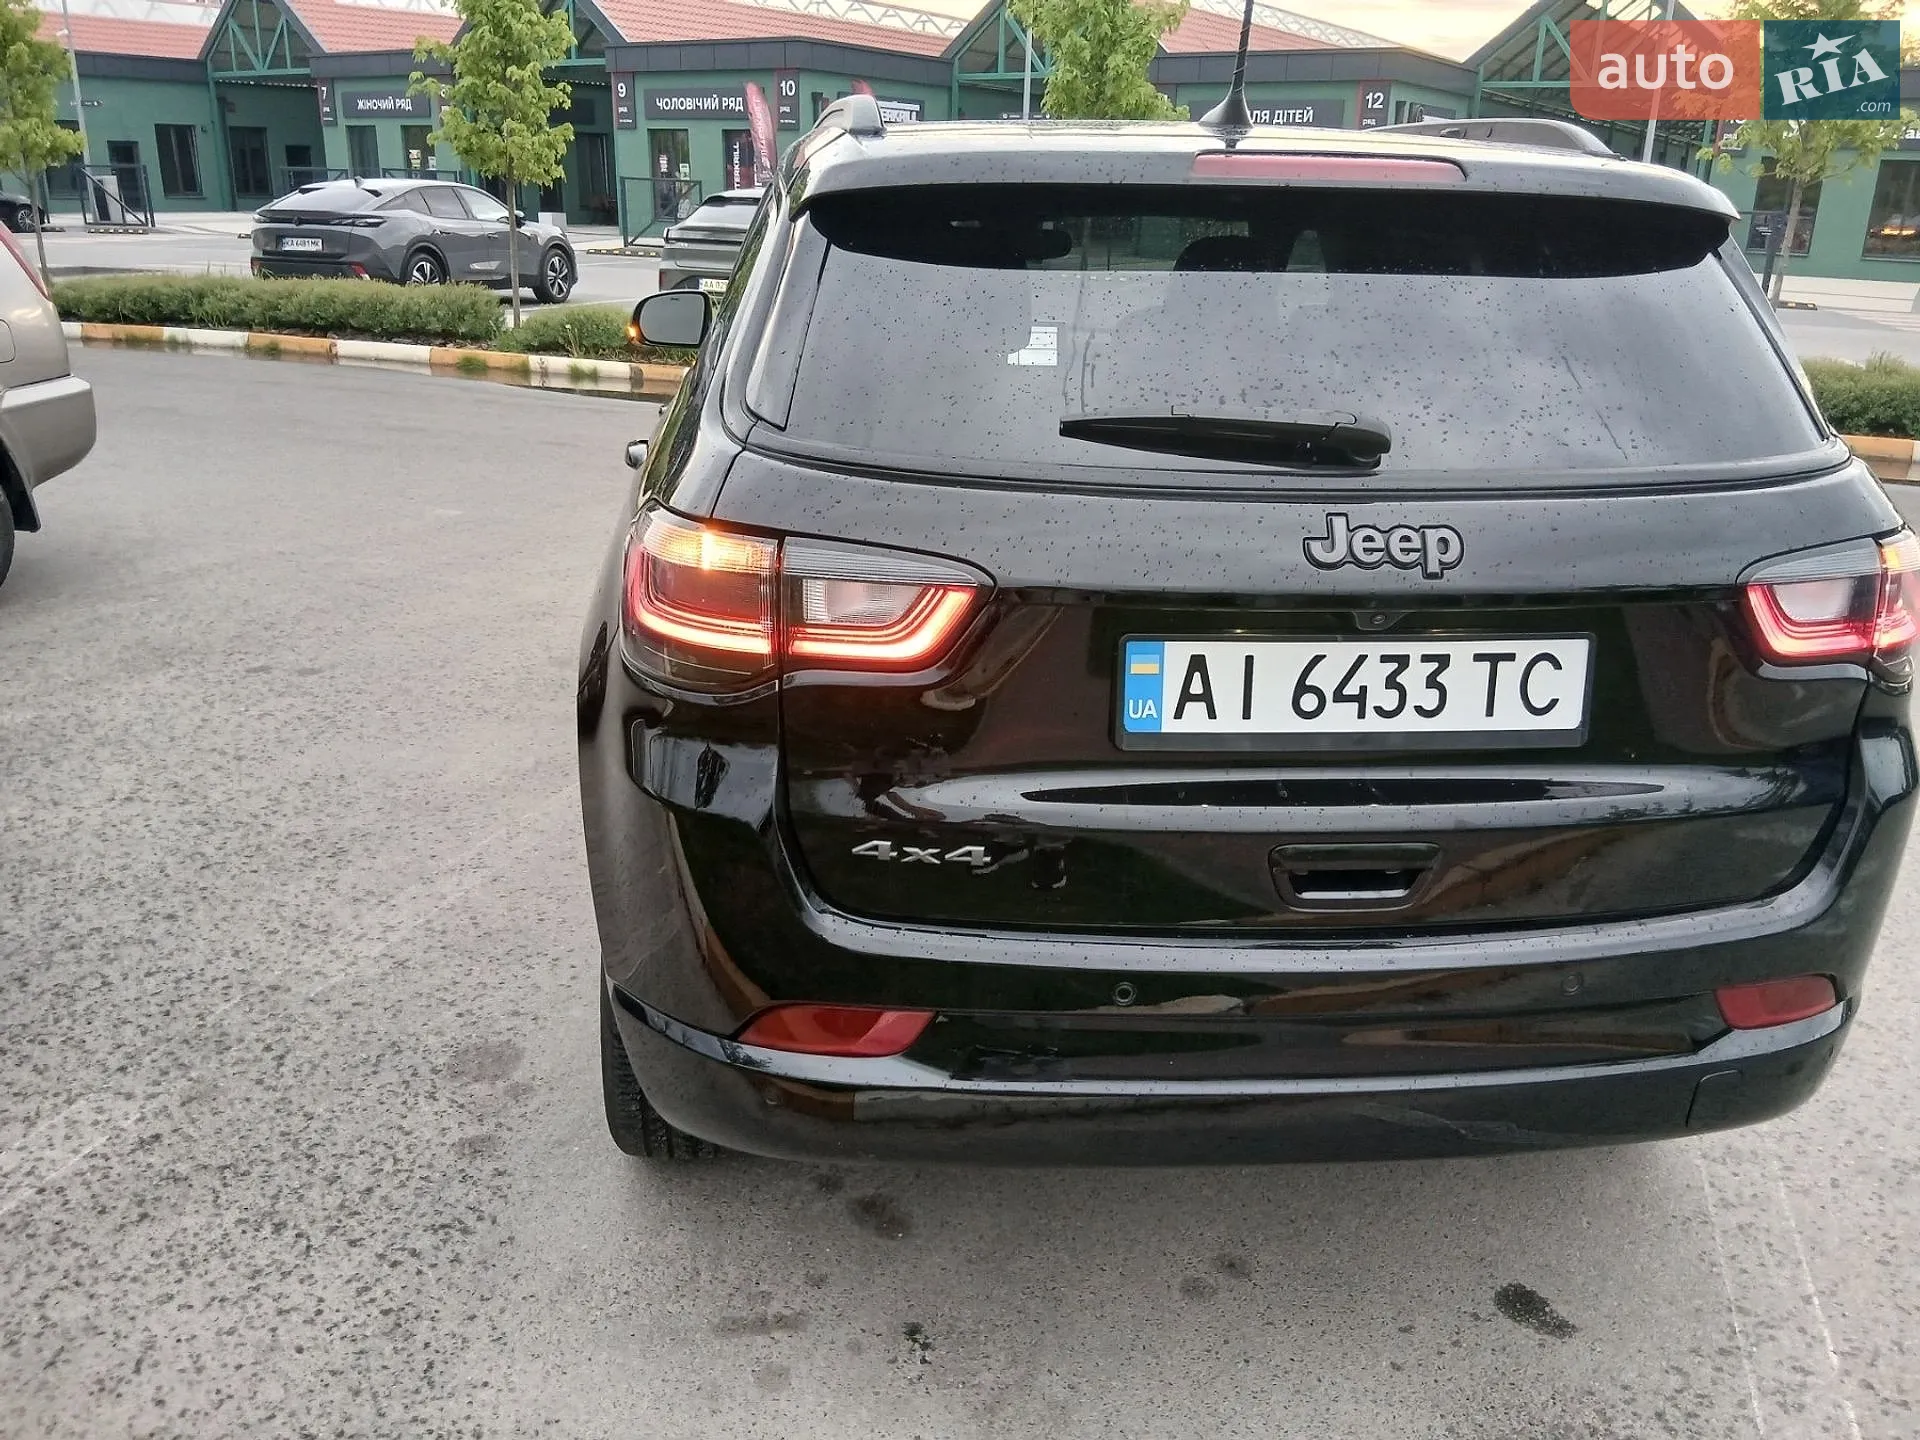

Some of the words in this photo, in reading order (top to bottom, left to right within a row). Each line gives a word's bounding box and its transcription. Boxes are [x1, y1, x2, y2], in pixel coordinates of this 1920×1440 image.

[321, 86, 328, 100] 7
[617, 82, 626, 98] 9
[780, 80, 796, 96] 10
[357, 96, 394, 111] ЖІНОЧИЙ
[396, 98, 412, 111] РЯД
[656, 94, 720, 111] ЧОЛОВІЧИЙ
[722, 97, 744, 113] РЯД
[1365, 92, 1384, 109] 12
[1251, 109, 1270, 124] ЛЯ
[1273, 106, 1314, 126] ДІТЕЙ
[1362, 117, 1376, 126] ряд
[733, 141, 741, 190] TERKRILL
[1303, 512, 1465, 579] Jeep
[1173, 654, 1255, 720] AI
[1291, 654, 1452, 720] 6433
[1473, 652, 1564, 718] TC
[1128, 699, 1158, 719] UA
[852, 840, 992, 866] 4x4
